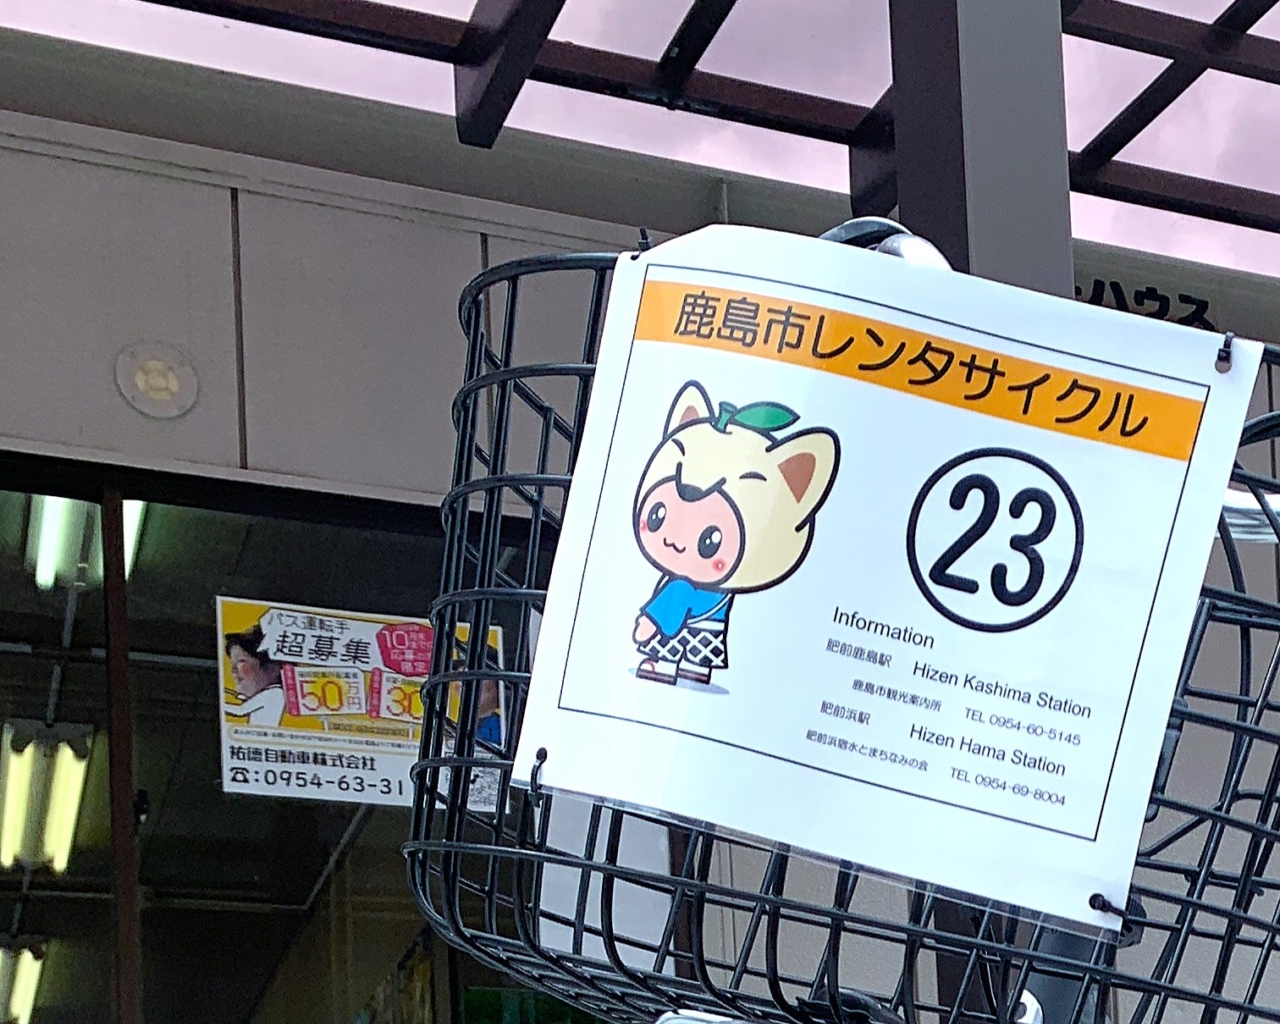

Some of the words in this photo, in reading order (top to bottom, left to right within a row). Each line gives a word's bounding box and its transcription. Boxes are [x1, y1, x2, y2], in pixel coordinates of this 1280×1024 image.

[1075, 278, 1216, 331] ハウス
[674, 291, 1149, 437] 鹿島市レンタサイクル
[929, 473, 1057, 607] 23
[267, 611, 350, 635] バス運転手
[833, 606, 935, 649] Information
[275, 630, 372, 664] 超募集
[826, 638, 893, 668] 肥前鹿島駅
[852, 678, 942, 712] 鹿島市観光案内所
[912, 661, 958, 686] Hizen
[963, 673, 1032, 704] Kashima
[1036, 692, 1092, 718] Station
[820, 700, 871, 725] 肥前浜駅
[965, 707, 985, 723] TEL
[989, 714, 1082, 746] 0954-60-5145
[909, 723, 955, 748] Hizen
[959, 736, 1006, 762] Hama
[1010, 749, 1066, 776] Station
[950, 766, 971, 784] TEL
[975, 774, 1066, 806] 0954-69-8004
